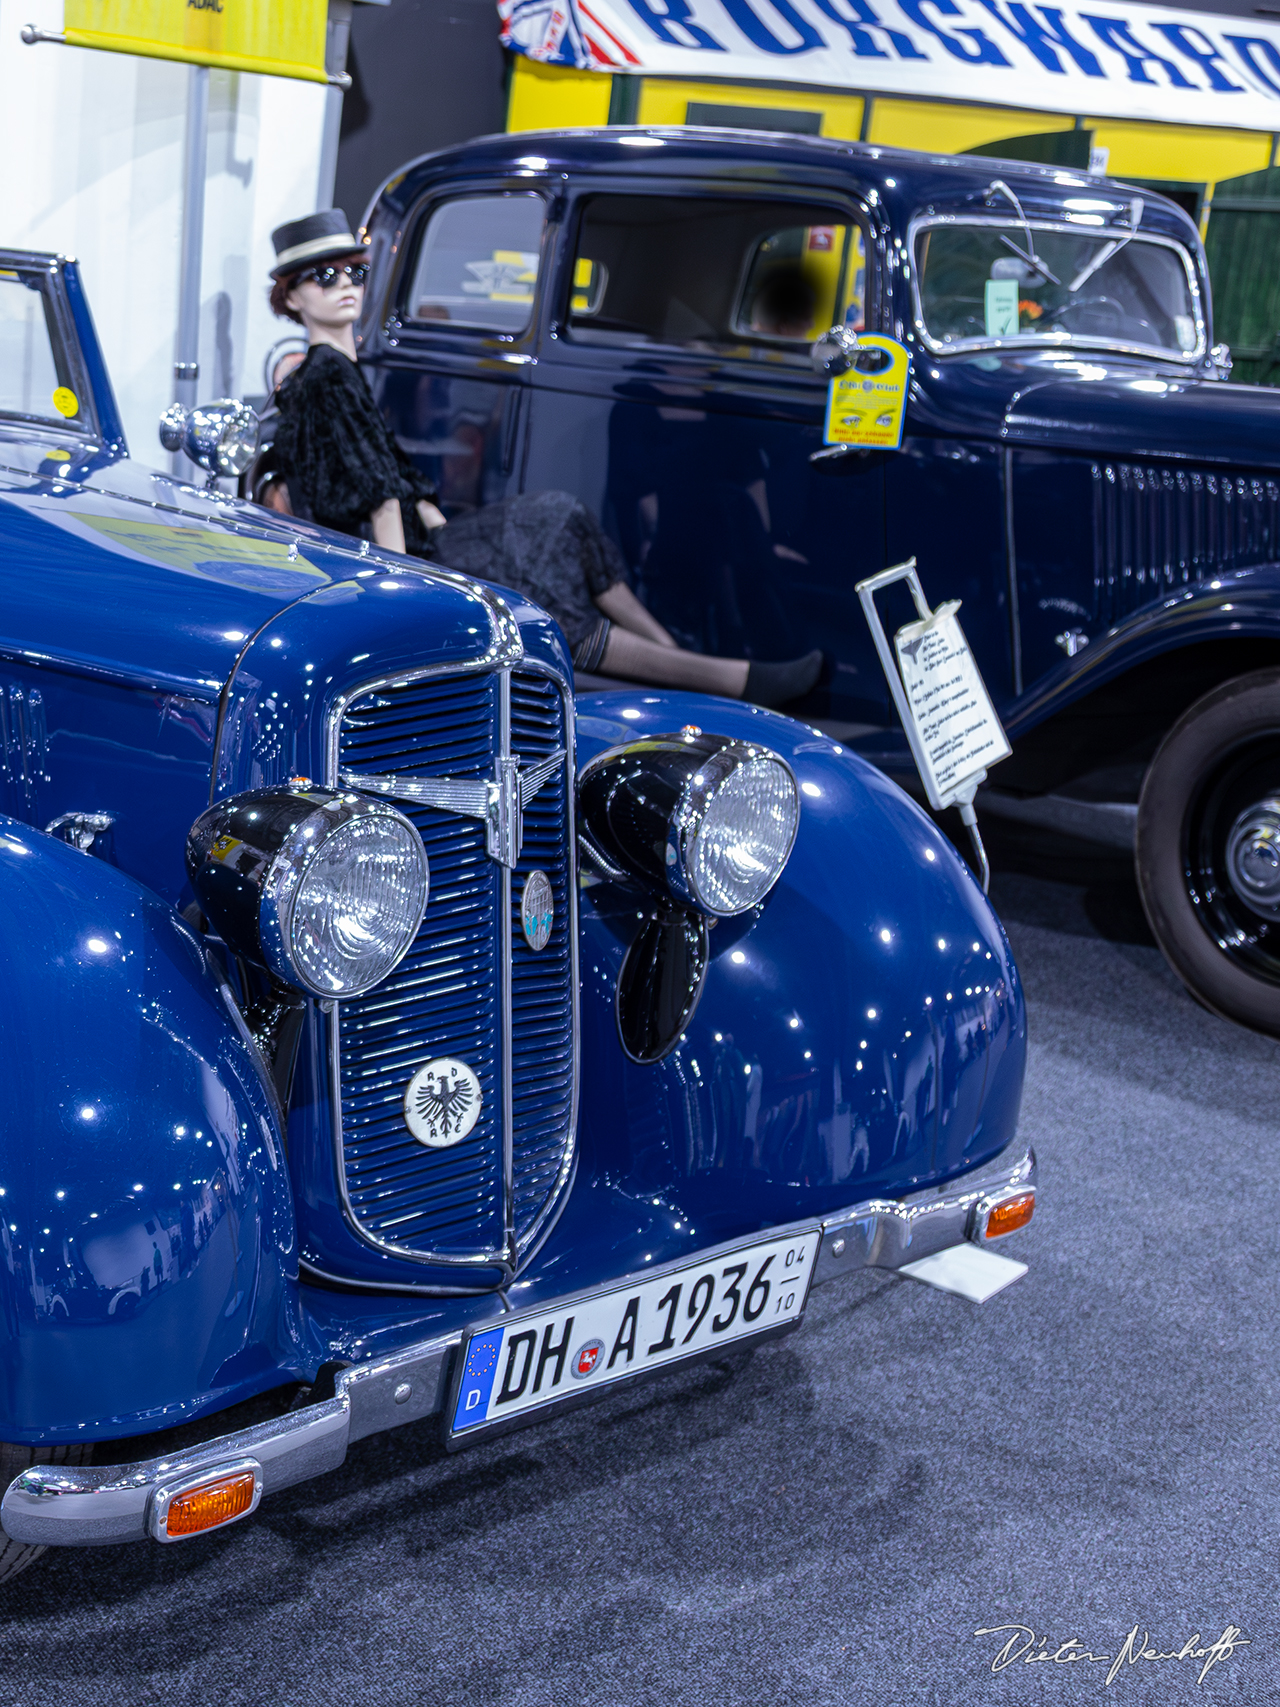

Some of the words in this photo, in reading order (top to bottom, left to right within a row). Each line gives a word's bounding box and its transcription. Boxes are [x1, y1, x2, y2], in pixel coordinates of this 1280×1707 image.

[785, 1246, 805, 1269] 04
[776, 1291, 796, 1315] 10
[465, 1388, 480, 1411] D
[495, 1315, 575, 1406] DH
